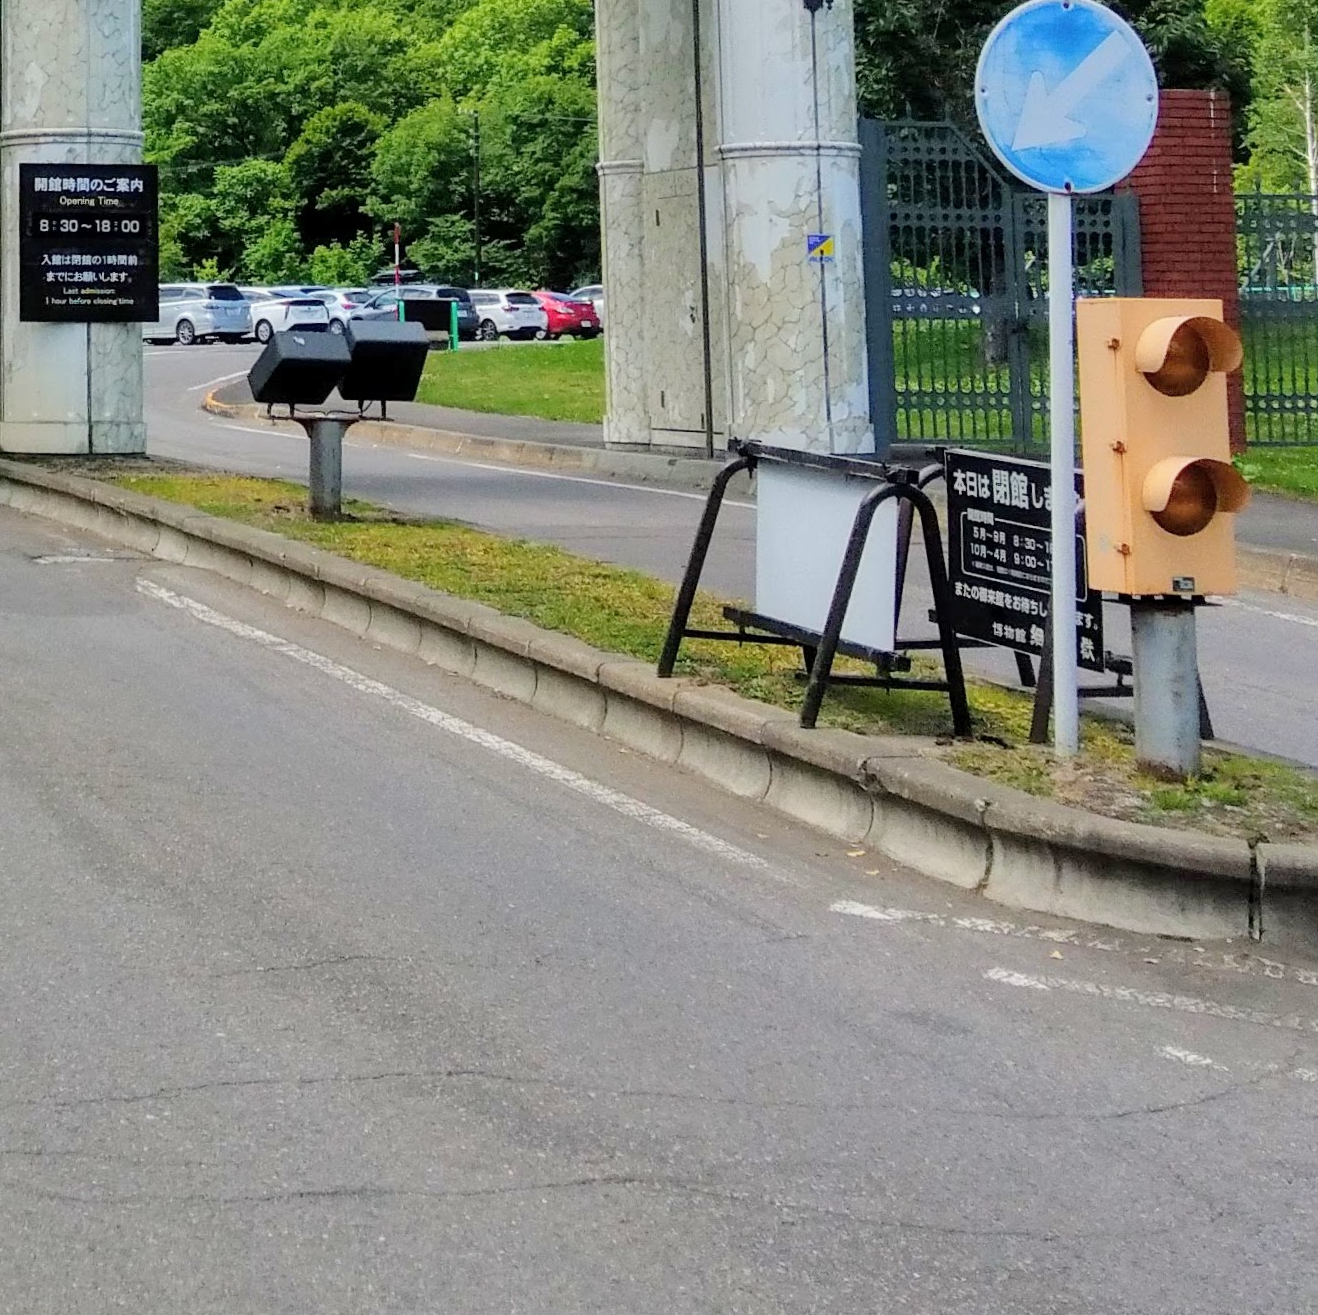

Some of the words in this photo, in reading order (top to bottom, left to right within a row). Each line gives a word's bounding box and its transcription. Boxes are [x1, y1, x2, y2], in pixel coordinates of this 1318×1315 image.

[34, 177, 144, 192] 開館時間のご案内
[59, 196, 95, 206] Opening
[98, 196, 119, 205] Time
[42, 254, 138, 266] 入館は閉館の1時間前
[46, 271, 132, 283] までにお願いします。
[63, 287, 79, 295] Last
[51, 297, 67, 305] hour
[69, 297, 91, 305] before
[93, 297, 117, 306] closing
[118, 297, 134, 305] time
